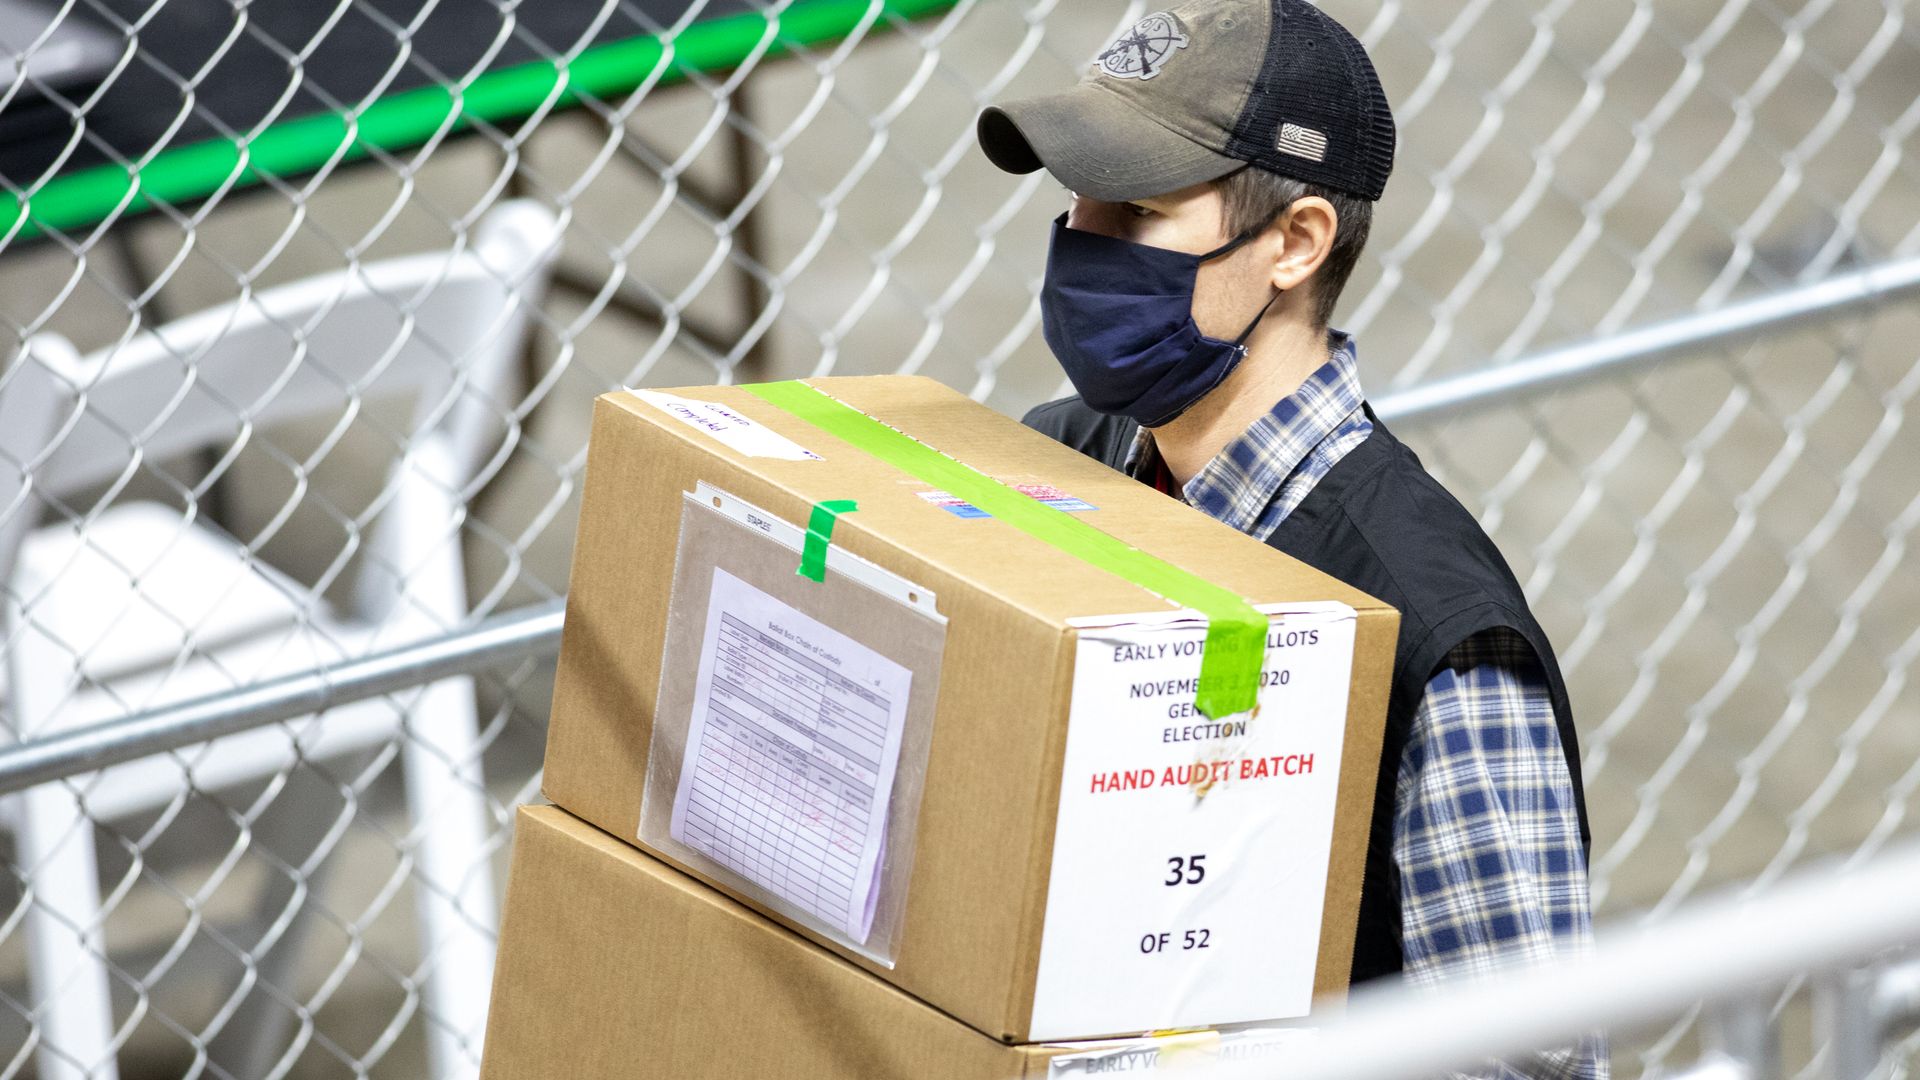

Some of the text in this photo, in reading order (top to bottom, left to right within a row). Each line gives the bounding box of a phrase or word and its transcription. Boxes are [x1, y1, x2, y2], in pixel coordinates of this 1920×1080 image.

[1112, 643, 1167, 662] EARLY
[1251, 670, 1290, 689] 020
[1163, 721, 1247, 743] ELECTION
[1090, 753, 1314, 793] HAND AUDIT BATCH
[1164, 854, 1206, 887] 35
[1140, 928, 1211, 954] OF 52
[1085, 1053, 1138, 1075] EARLY
